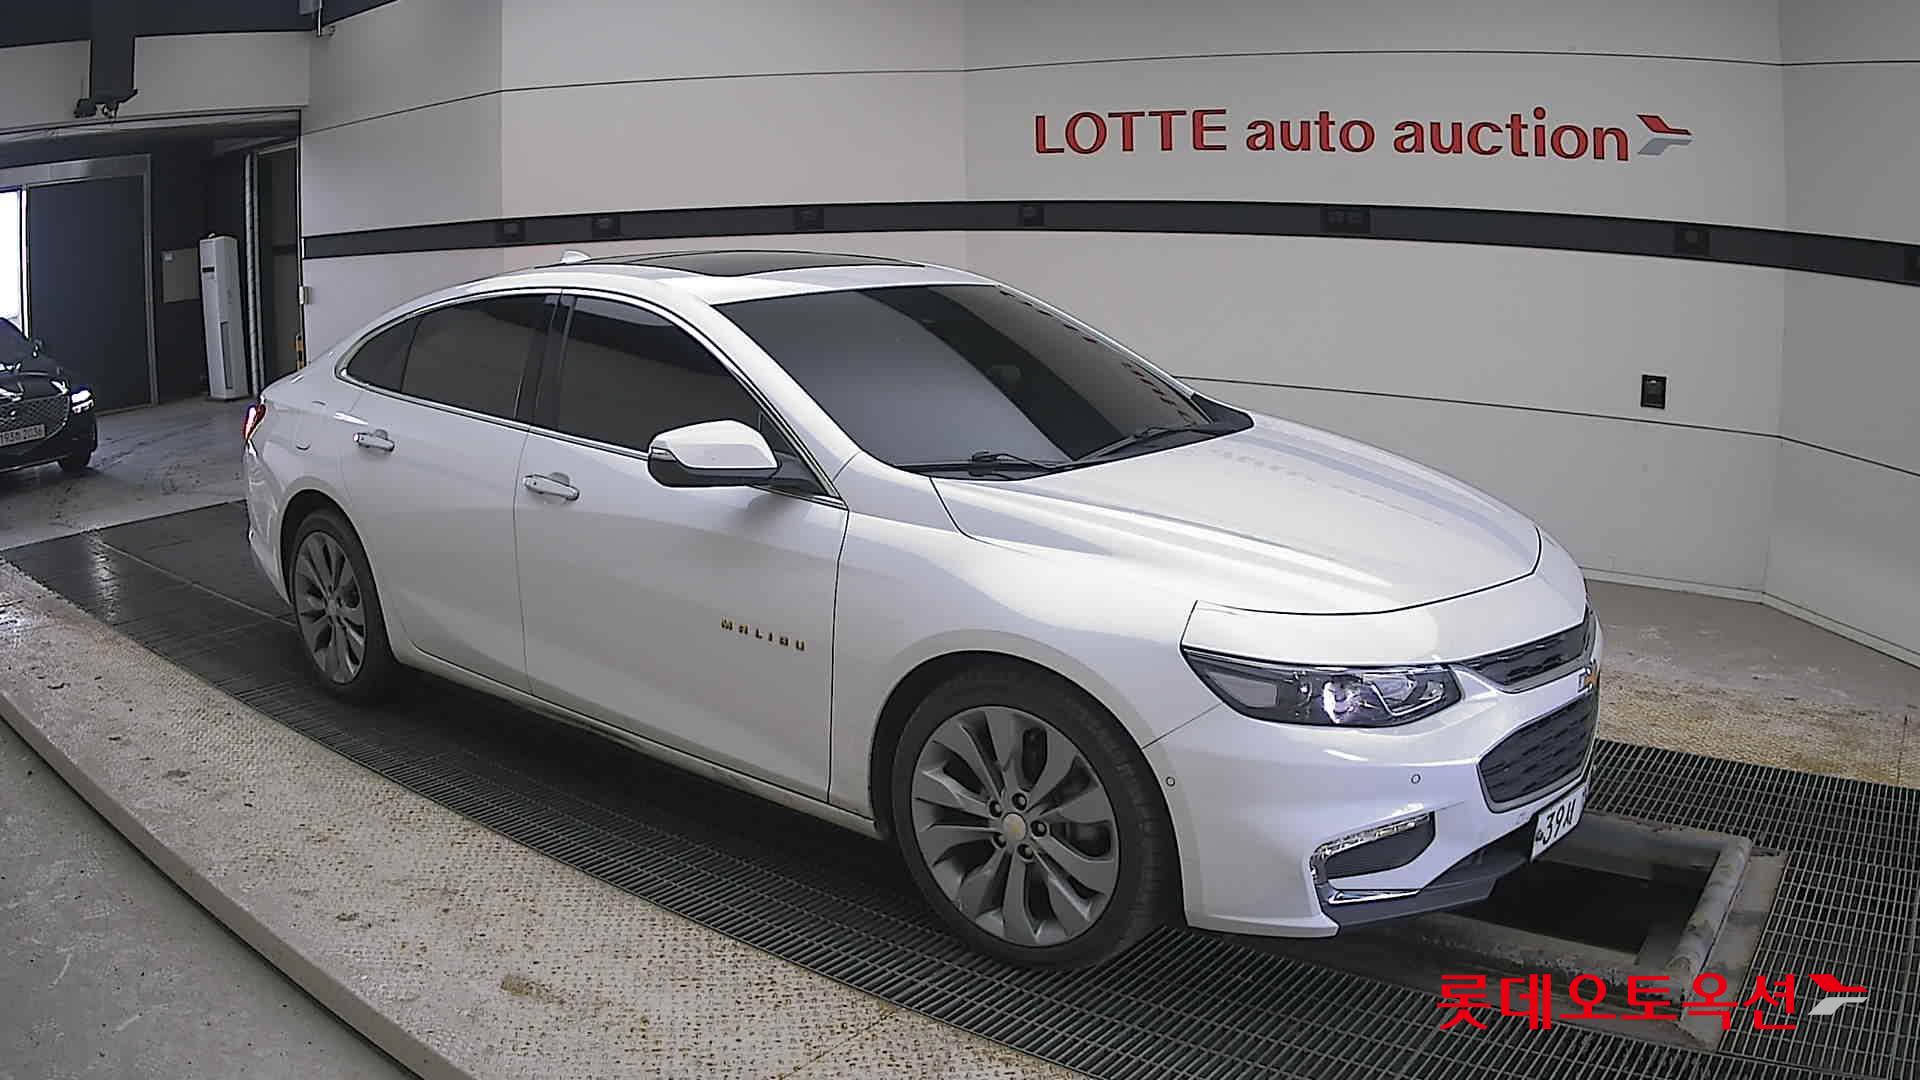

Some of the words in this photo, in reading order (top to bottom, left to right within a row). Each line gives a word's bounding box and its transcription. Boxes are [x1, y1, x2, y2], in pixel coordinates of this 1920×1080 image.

[1035, 109, 1227, 154] LOTTE
[1247, 113, 1376, 152] auto
[1394, 107, 1629, 160] auction
[721, 616, 805, 651] MALIBU
